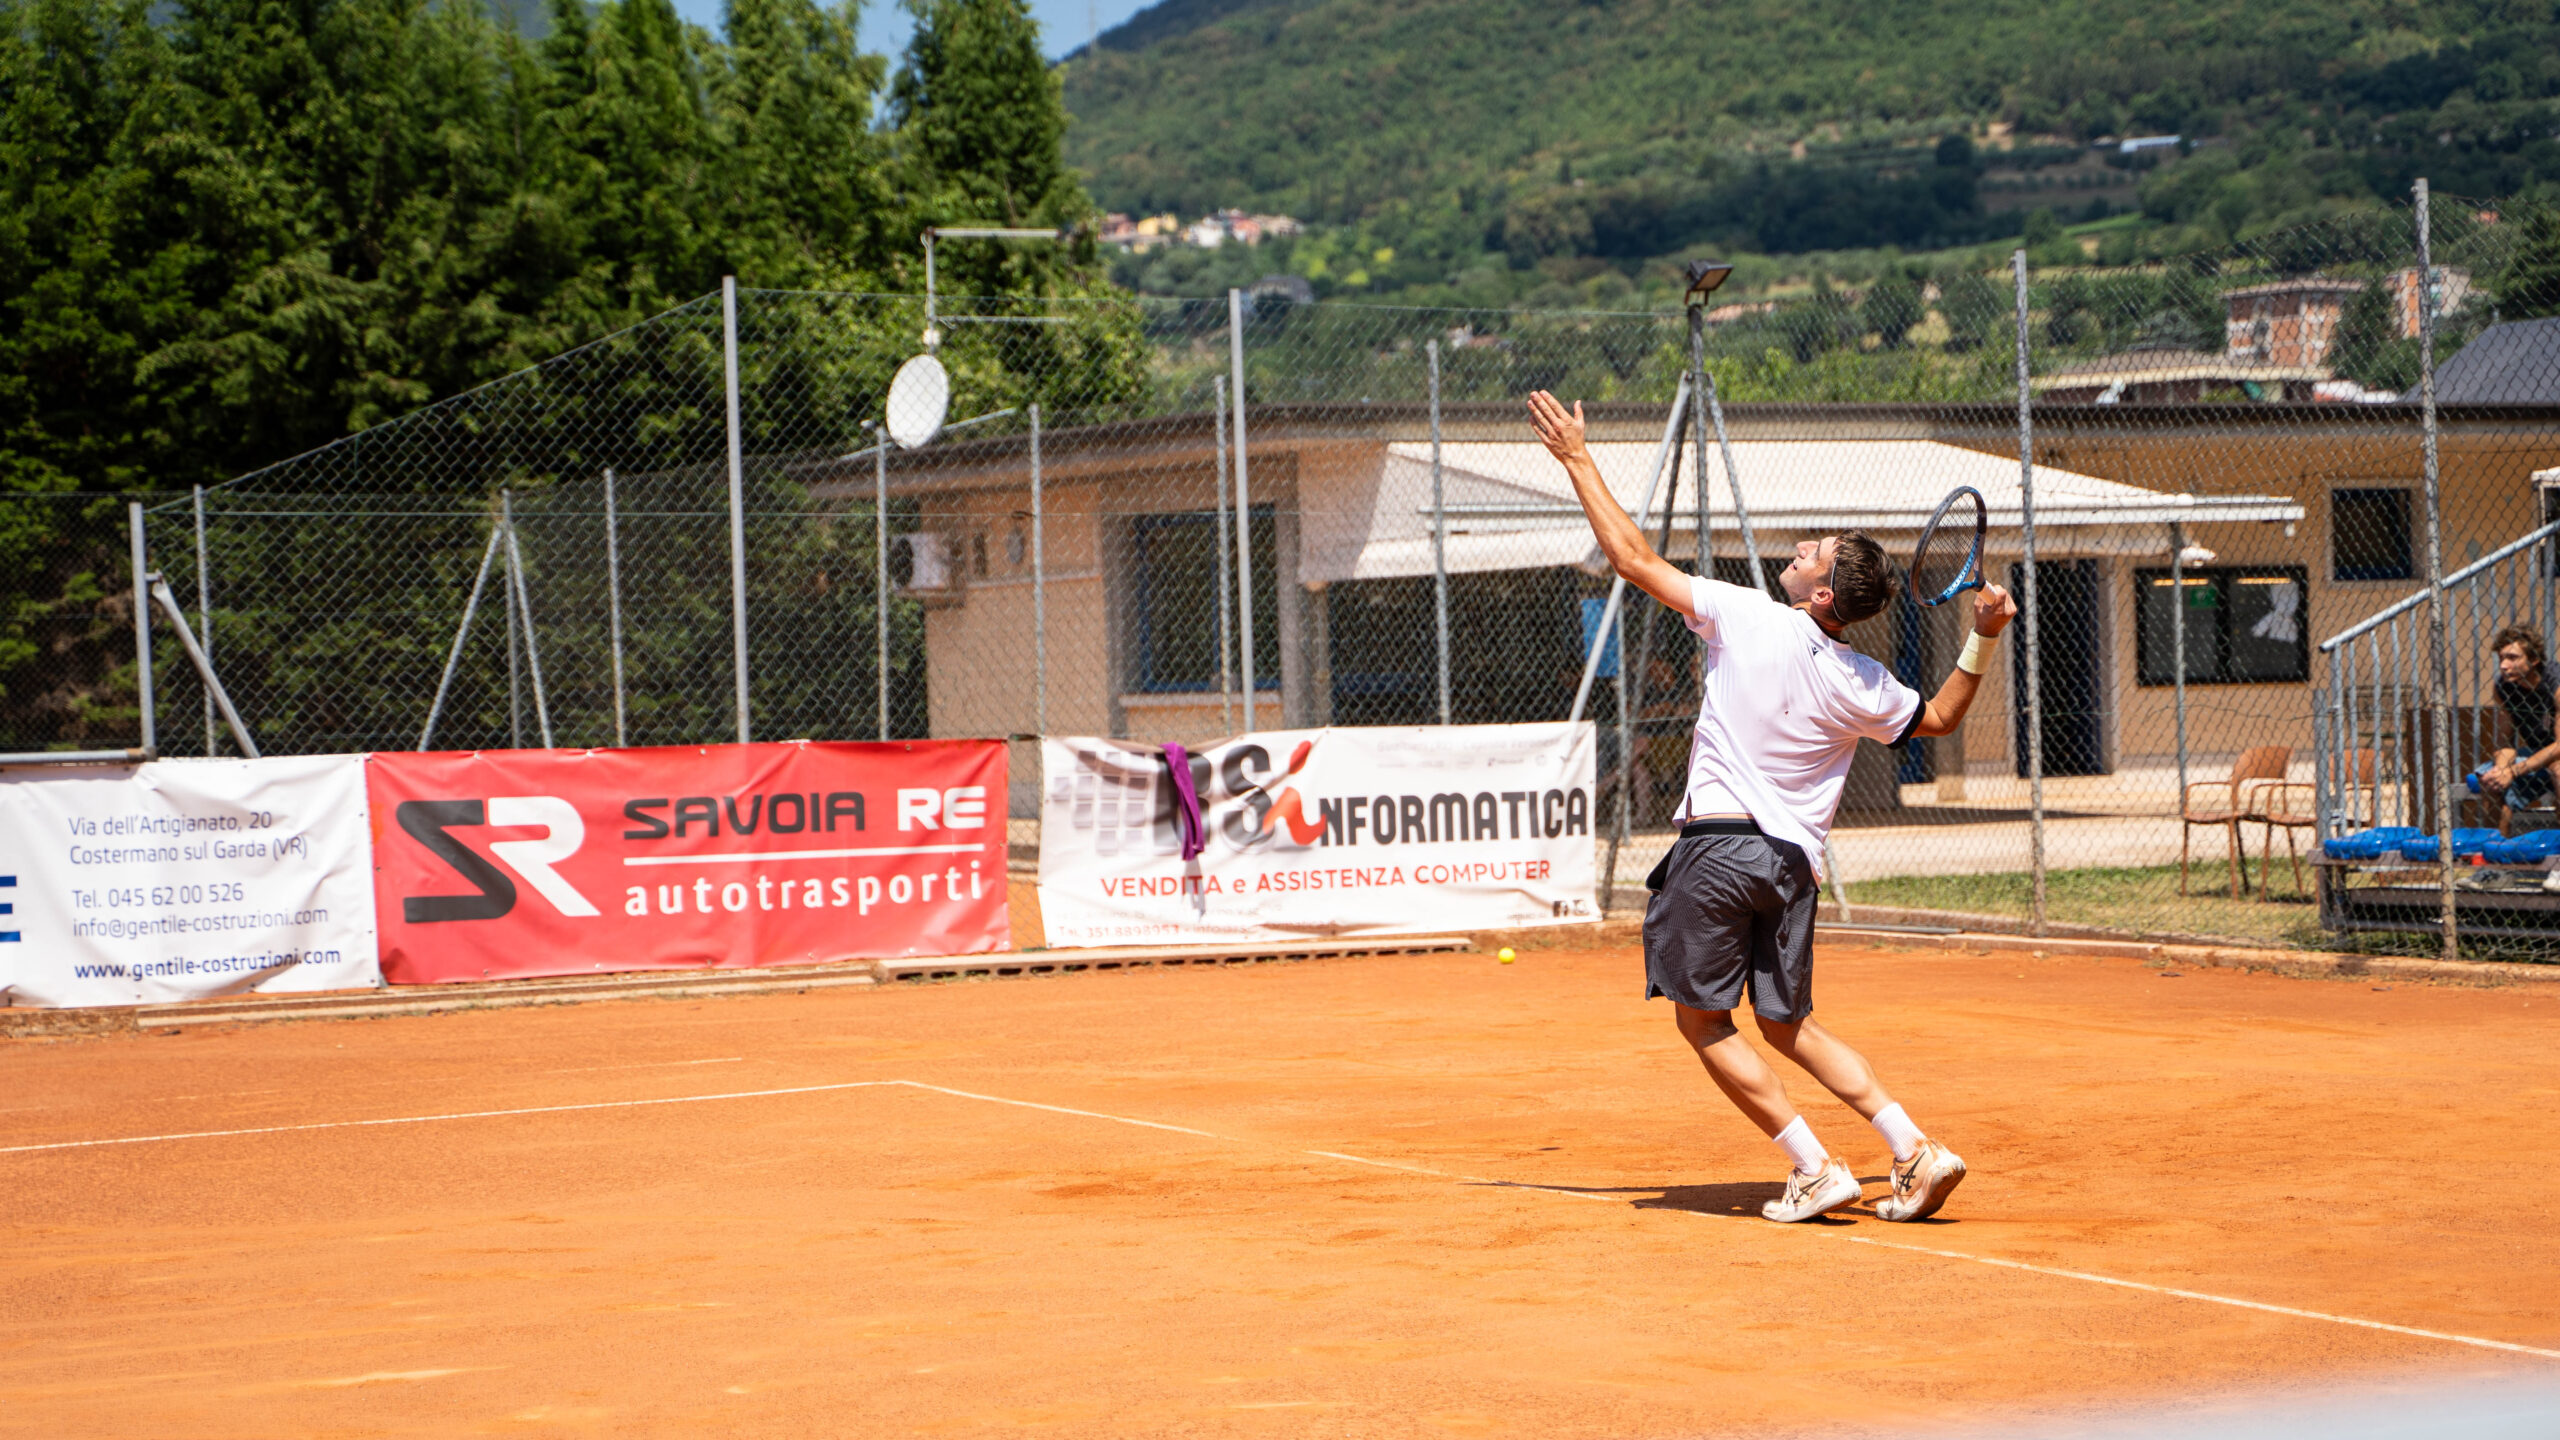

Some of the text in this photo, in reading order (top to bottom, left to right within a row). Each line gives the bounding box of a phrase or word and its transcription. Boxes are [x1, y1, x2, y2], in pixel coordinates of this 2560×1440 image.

[68, 811, 272, 838] Via dell'Artigianato, 20
[623, 786, 986, 840] SAVOIA RE
[70, 835, 308, 865] Costermano sul Garda (VR)
[624, 860, 982, 916] autotrasporti
[1101, 859, 1551, 898] VENDITA e ASSISTENZA COMPUTER
[72, 883, 244, 909] Tel. 045 62 00 526
[73, 907, 328, 940] info@gentile-costruzioni.com
[75, 949, 341, 981] www.gentile-costruzioni.com
